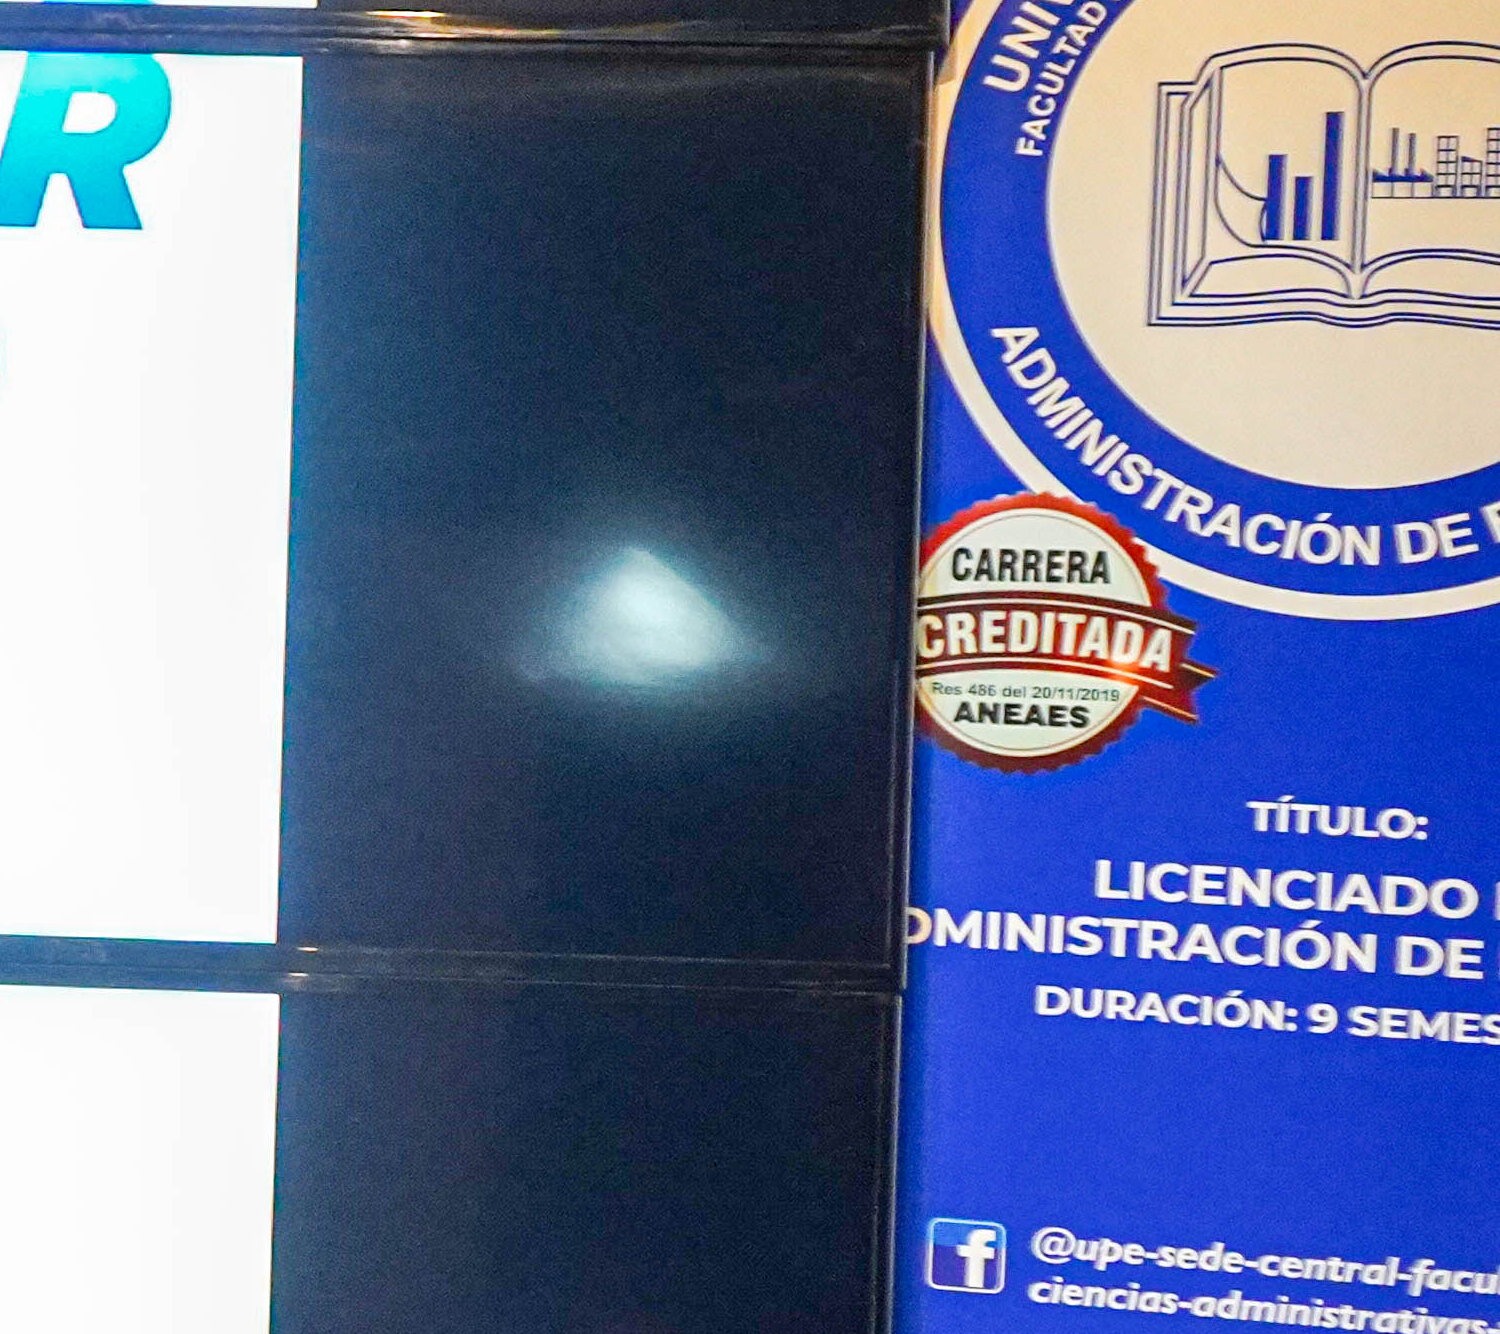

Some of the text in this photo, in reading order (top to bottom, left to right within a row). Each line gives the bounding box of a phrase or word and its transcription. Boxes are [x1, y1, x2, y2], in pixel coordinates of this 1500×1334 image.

[1014, 0, 1109, 158] FACULTAD
[990, 325, 1480, 567] ADMINISTRACIÓN DE
[951, 547, 1112, 584] CARRERA
[917, 610, 1173, 673] CREDITADA
[932, 681, 963, 696] Res
[1002, 684, 1027, 699] del
[1031, 686, 1121, 703] 20/11/2019
[953, 700, 1092, 729] ANEAES
[1245, 794, 1430, 841] TÍTULO:
[1093, 858, 1480, 920] LICENCIADO
[1394, 934, 1486, 980] DE
[1033, 983, 1299, 1032] DURACIÓN:
[1305, 1002, 1339, 1035] 9
[1029, 1225, 1500, 1298] @upe-sede-central-facu
